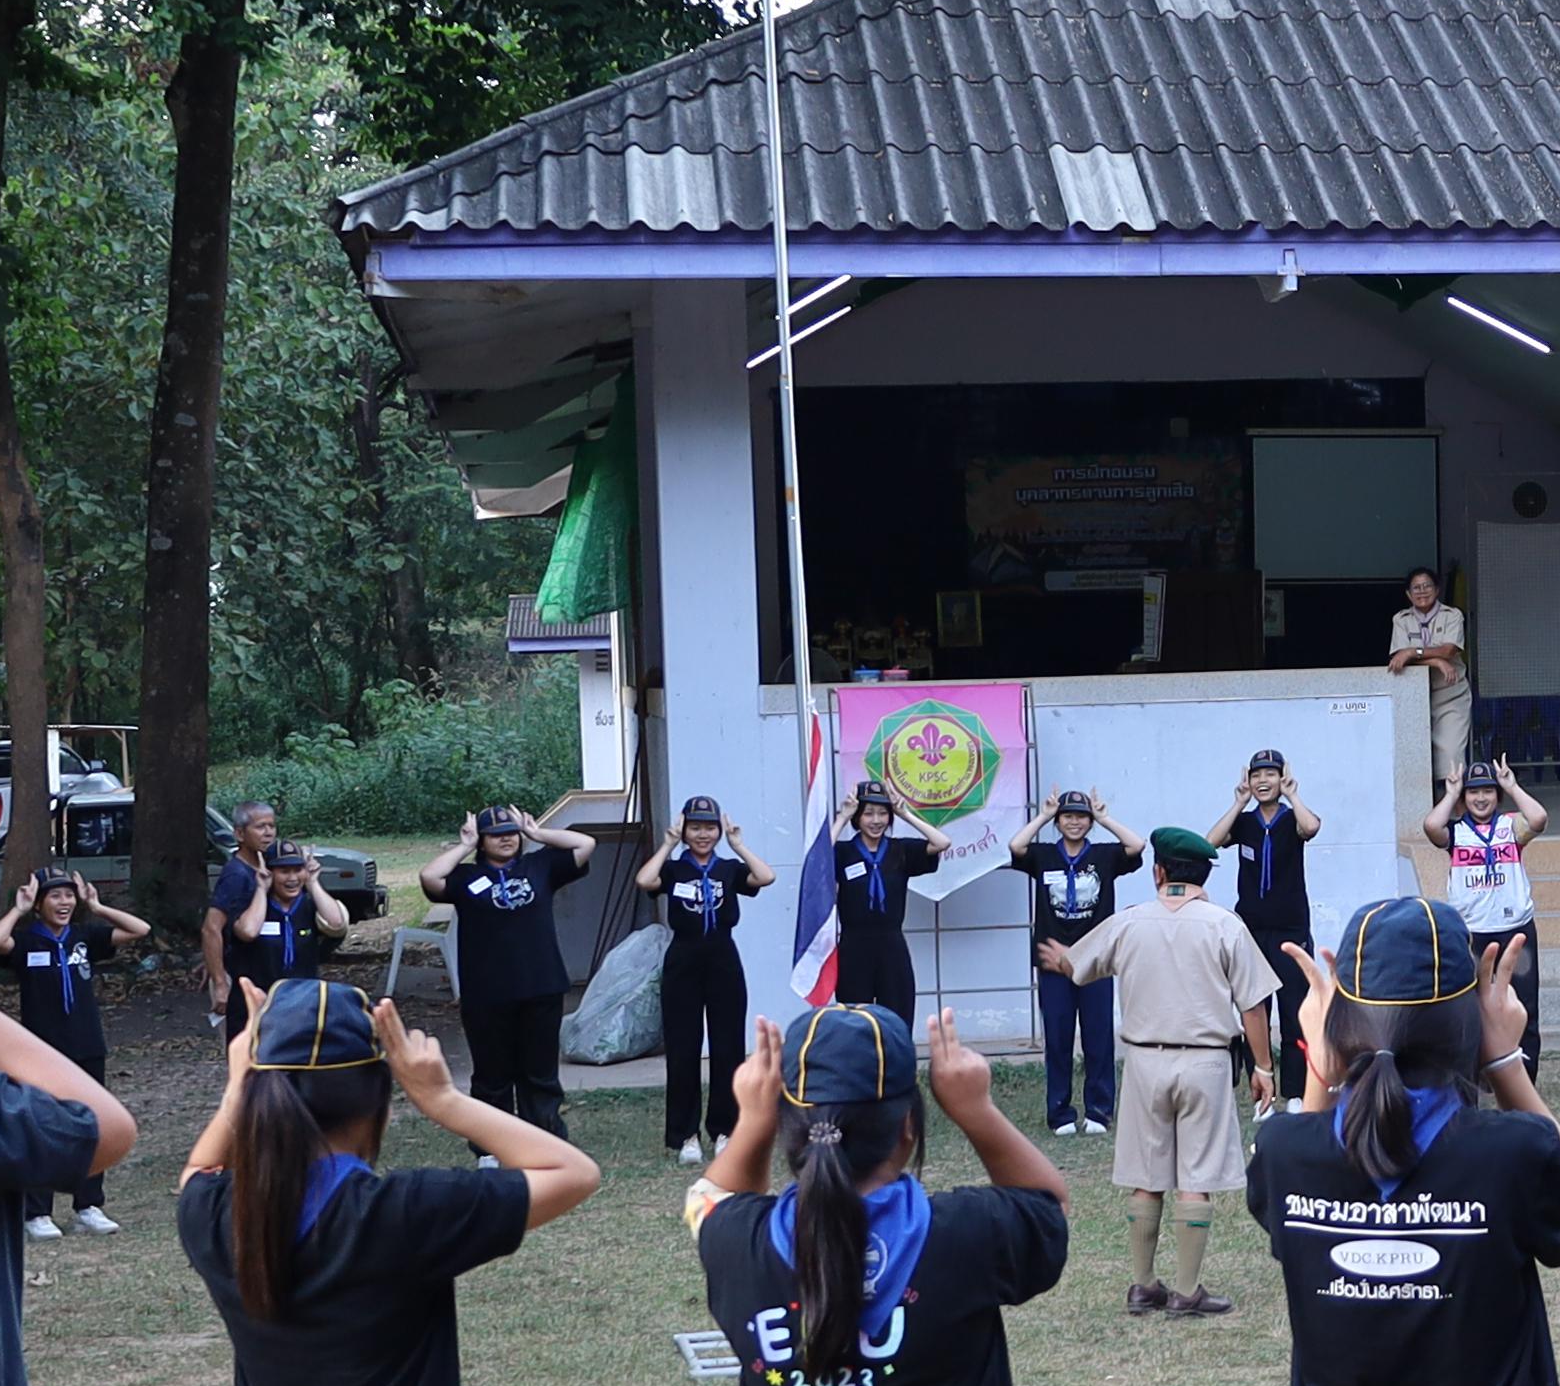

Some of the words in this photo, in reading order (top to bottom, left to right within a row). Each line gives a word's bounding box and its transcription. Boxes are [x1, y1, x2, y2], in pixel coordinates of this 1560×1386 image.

[1053, 463, 1157, 482] การฝึกอบรม
[919, 771, 949, 783] KPSC
[1285, 1193, 1486, 1224] ชมรมอาสาพัฒนา
[756, 1307, 905, 1362] EU
